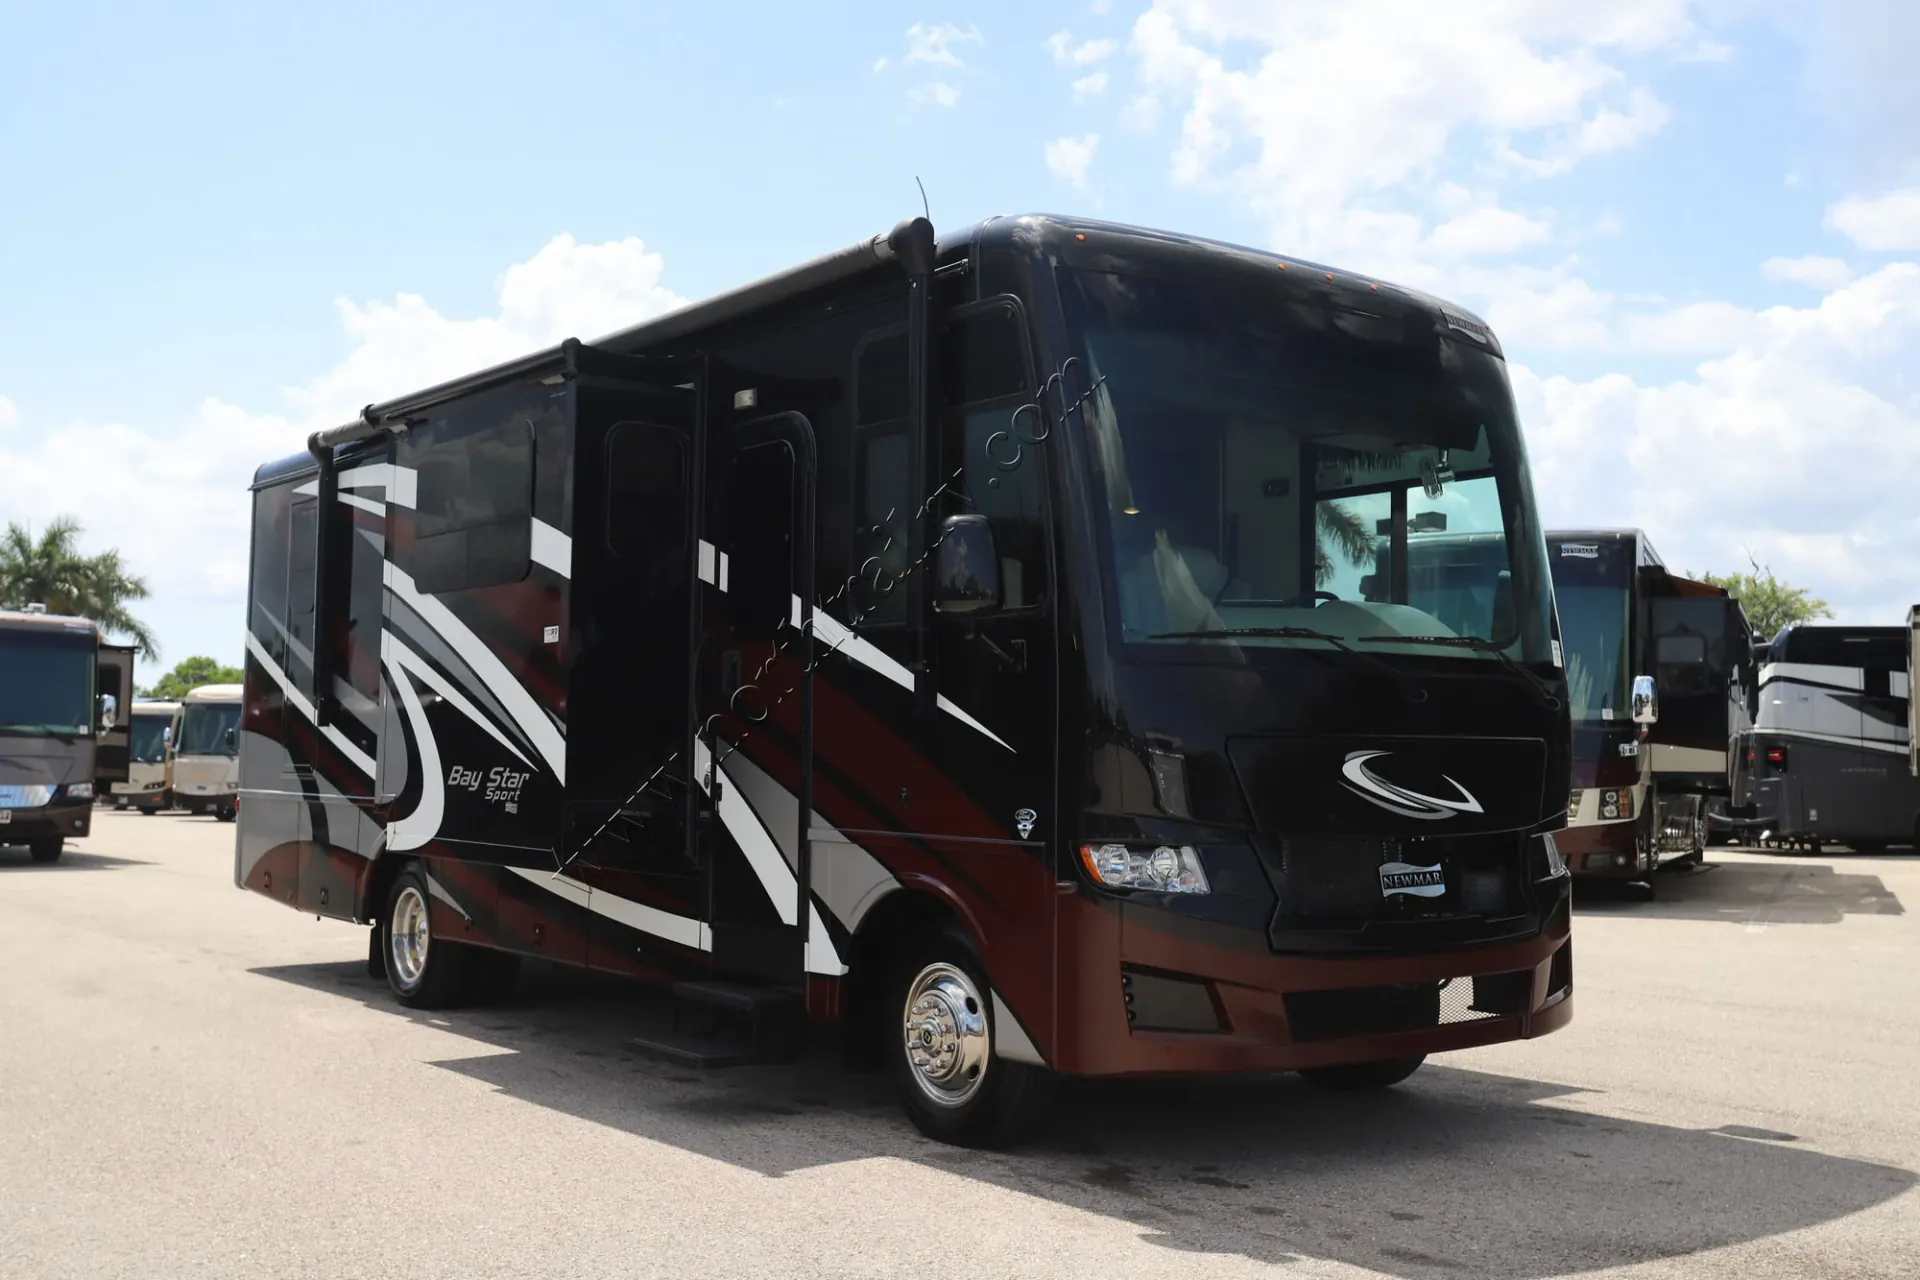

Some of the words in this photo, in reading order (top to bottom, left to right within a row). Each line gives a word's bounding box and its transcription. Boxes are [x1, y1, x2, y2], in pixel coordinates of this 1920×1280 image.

[448, 765, 483, 791] Bay
[486, 766, 530, 788] Star
[484, 787, 521, 803] Sport
[1383, 872, 1442, 888] NEWMAR
